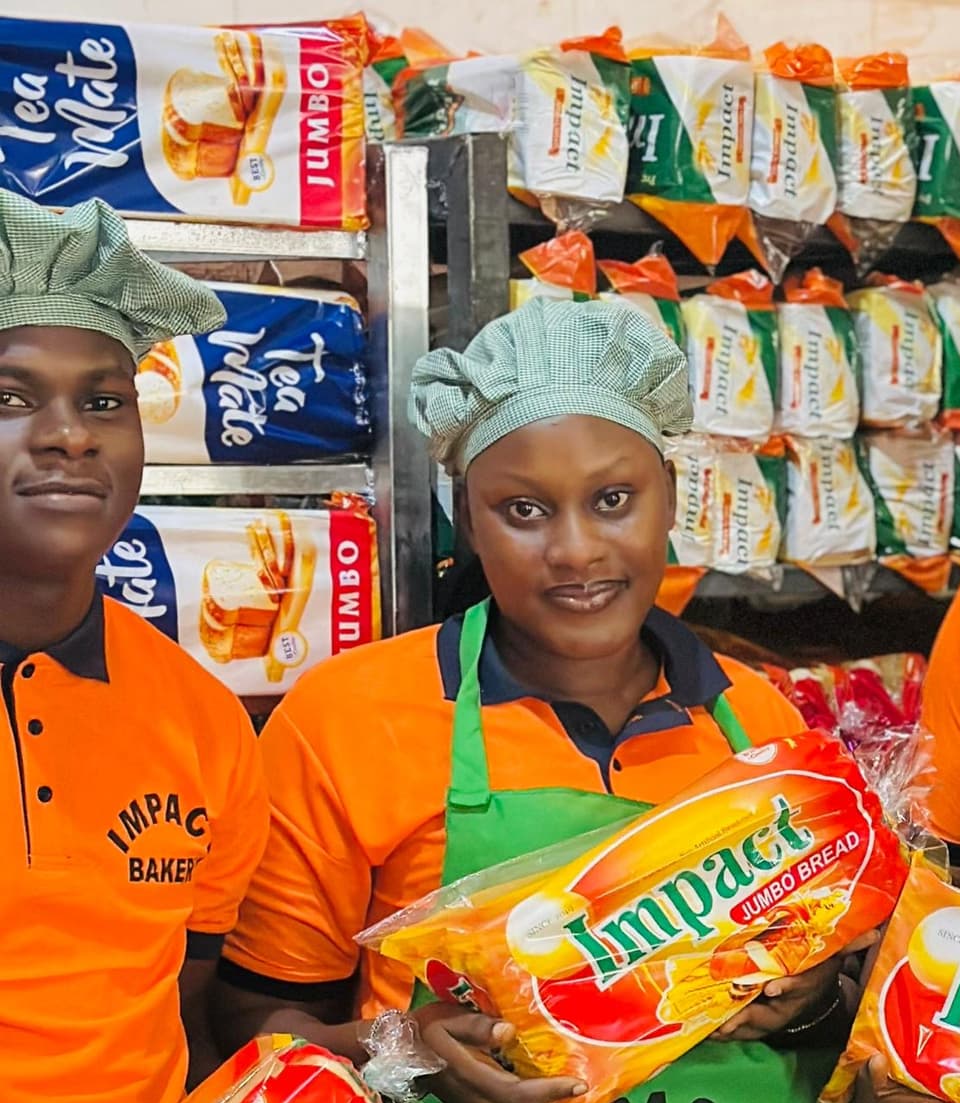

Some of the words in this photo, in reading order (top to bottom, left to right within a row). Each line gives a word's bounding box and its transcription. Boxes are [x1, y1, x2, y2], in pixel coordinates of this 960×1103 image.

[54, 37, 129, 170] Mate
[305, 62, 335, 187] JUMBO
[565, 74, 588, 174] Impact
[717, 83, 735, 179] Impact
[783, 103, 798, 199] Impact
[207, 326, 266, 447] Mate
[265, 332, 325, 413] Tea
[337, 540, 360, 653] UMBO
[107, 793, 211, 854] IMPAC
[129, 857, 204, 883] BAKER
[563, 796, 813, 988] Impact
[741, 873, 796, 922] JUMBO
[798, 830, 861, 882] BREAD
